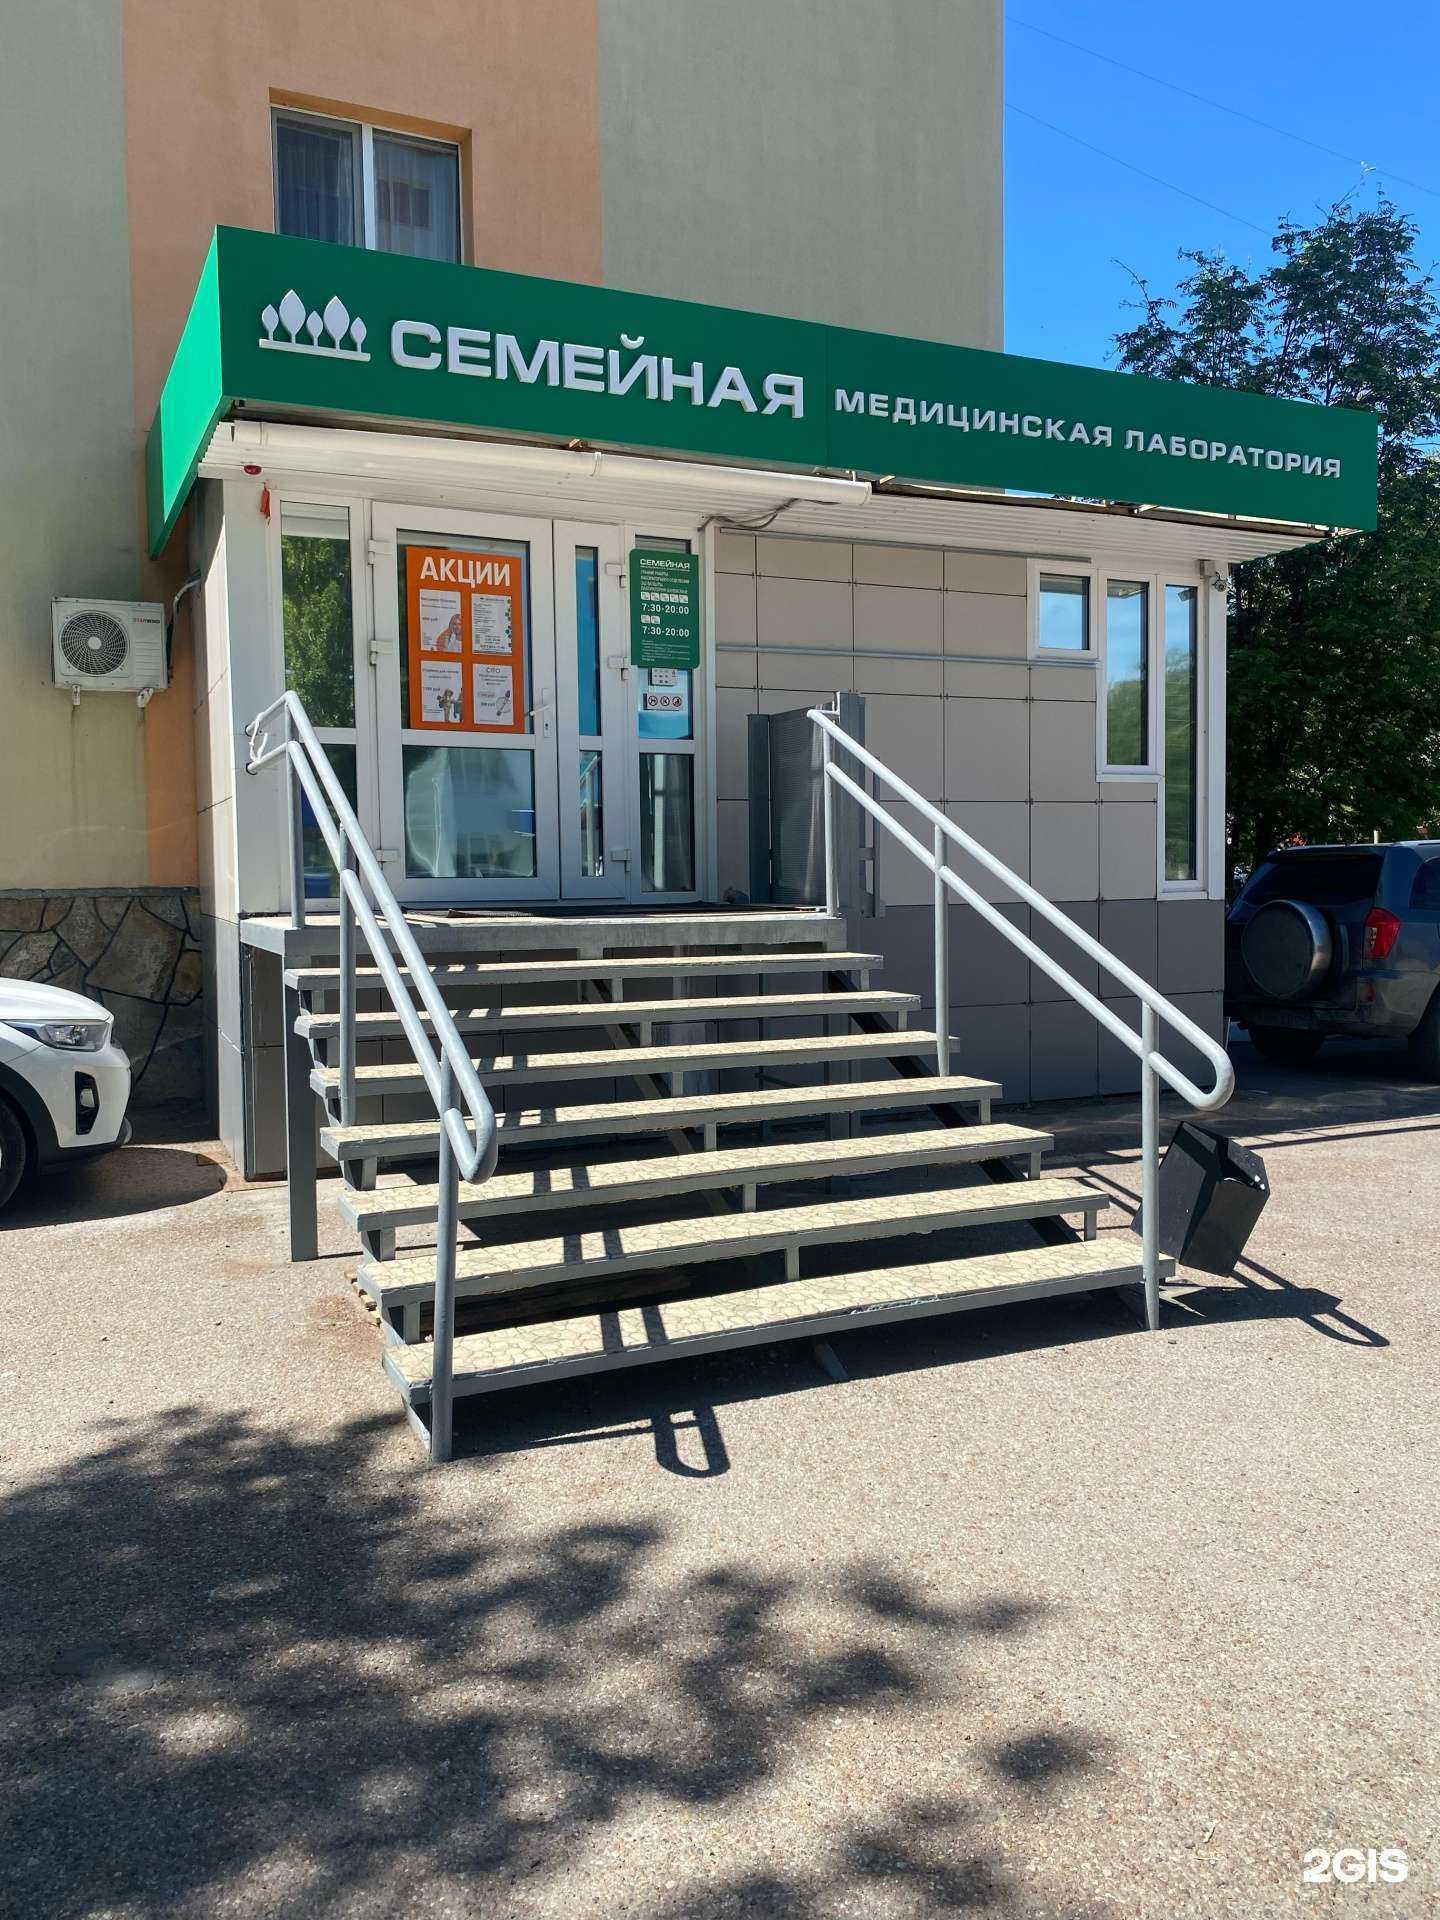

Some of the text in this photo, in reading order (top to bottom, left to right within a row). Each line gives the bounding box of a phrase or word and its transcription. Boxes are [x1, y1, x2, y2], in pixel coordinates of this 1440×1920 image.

[390, 319, 804, 419] СЕМЕЙНАЯ
[834, 388, 1342, 478] МЕДИЦИНСКАЯ ЛАБОРАТОРИЯ
[420, 556, 511, 588] АКЦИИ
[640, 558, 690, 569] СЕМЕЙНАЯ
[641, 602, 690, 615] 7:30-20:00
[641, 625, 690, 637] 7:30-20:00
